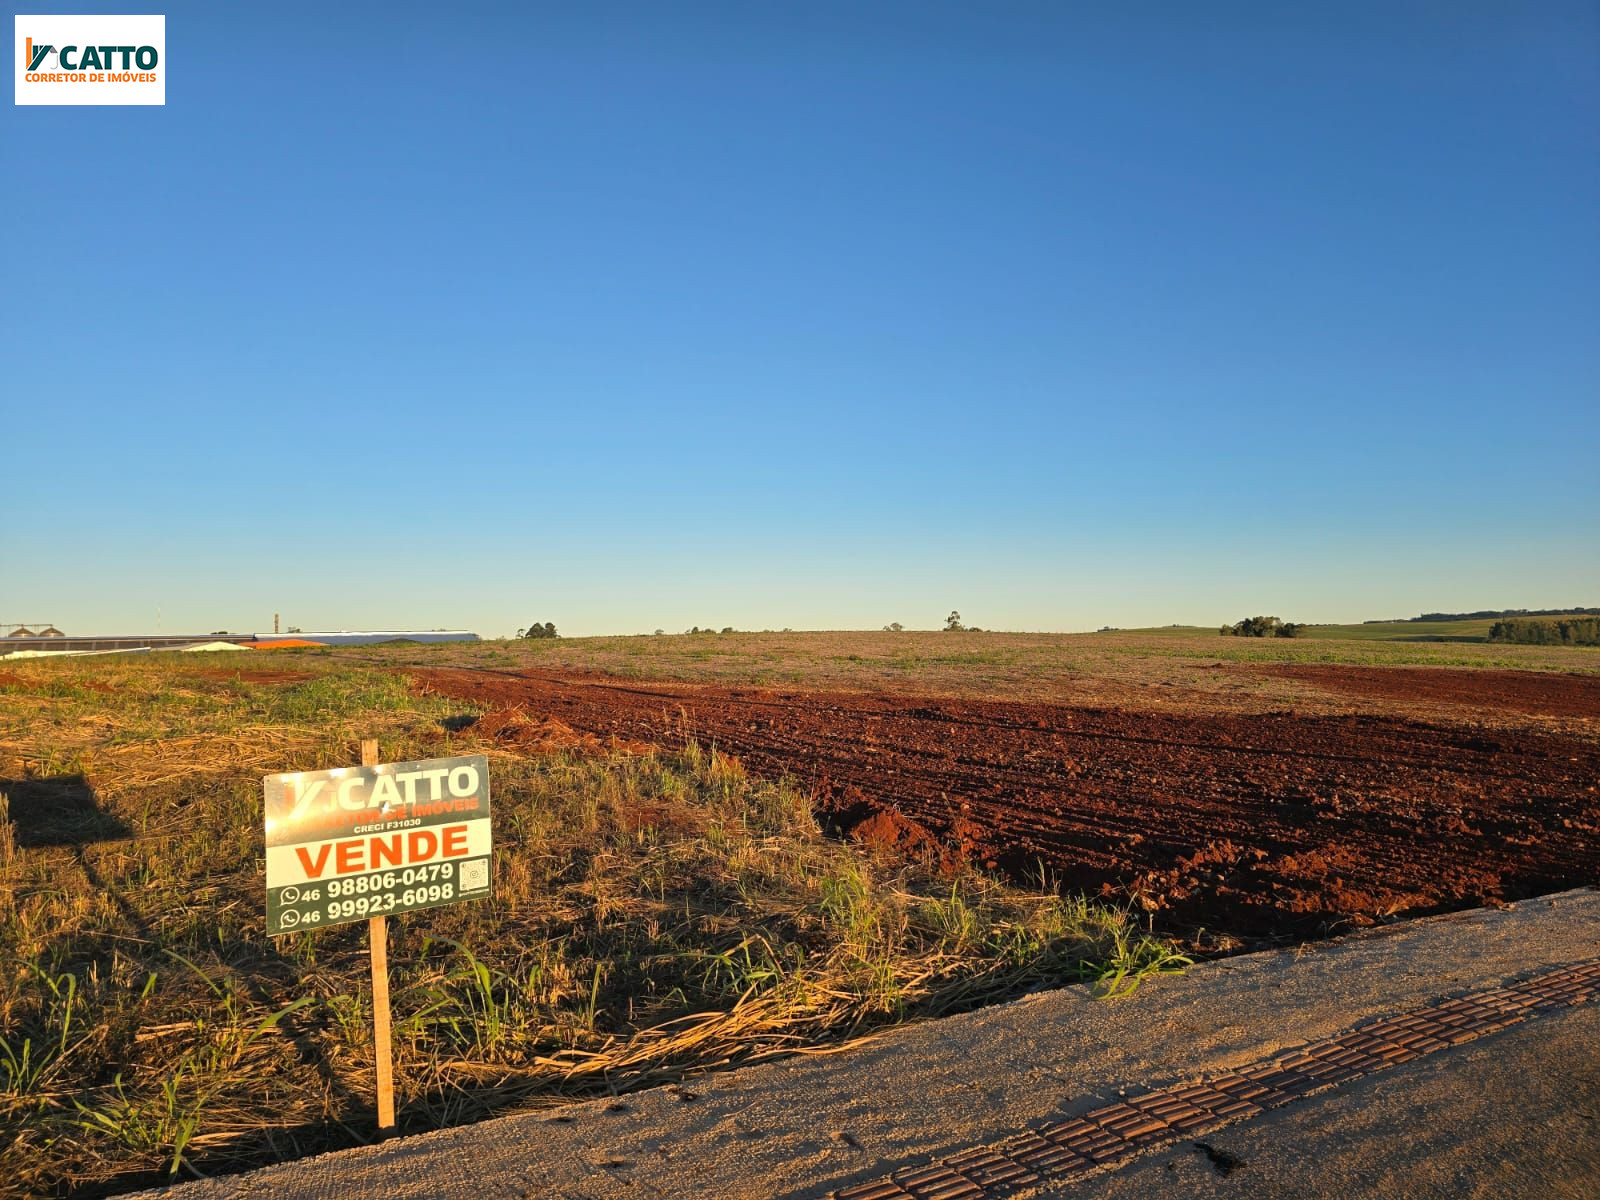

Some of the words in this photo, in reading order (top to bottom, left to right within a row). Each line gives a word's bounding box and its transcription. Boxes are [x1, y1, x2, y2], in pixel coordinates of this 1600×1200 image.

[337, 765, 480, 811] CATTO
[354, 823, 384, 834] CRECI
[387, 818, 421, 830] F31030
[295, 825, 469, 879] VENDE
[301, 889, 321, 902] 46
[327, 862, 454, 898] 98806-0479
[301, 910, 321, 924] 46
[327, 882, 454, 920] 99923-6098
